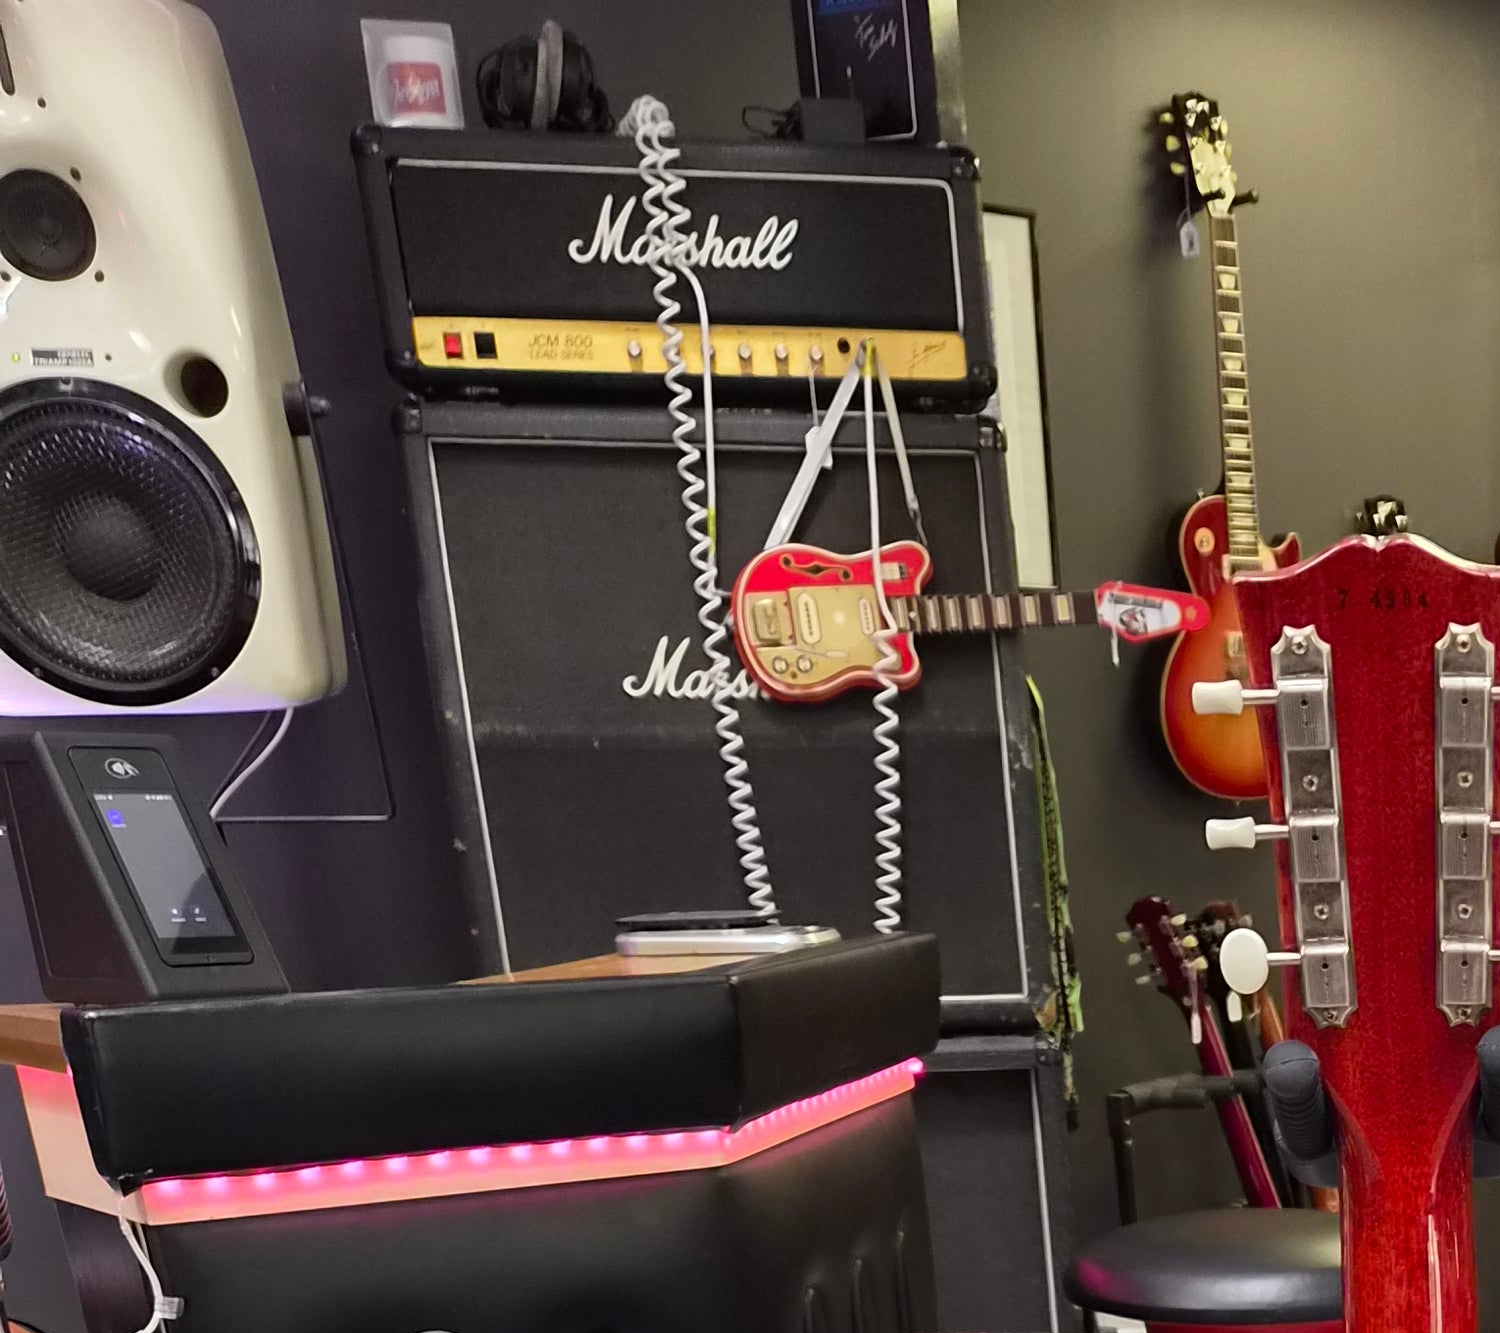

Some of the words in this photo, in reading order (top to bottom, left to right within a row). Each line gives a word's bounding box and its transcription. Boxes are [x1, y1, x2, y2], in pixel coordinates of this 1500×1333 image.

[528, 335, 559, 348] JCM
[565, 335, 593, 348] 800
[530, 351, 559, 360] LEAD
[562, 350, 593, 360] SERIES
